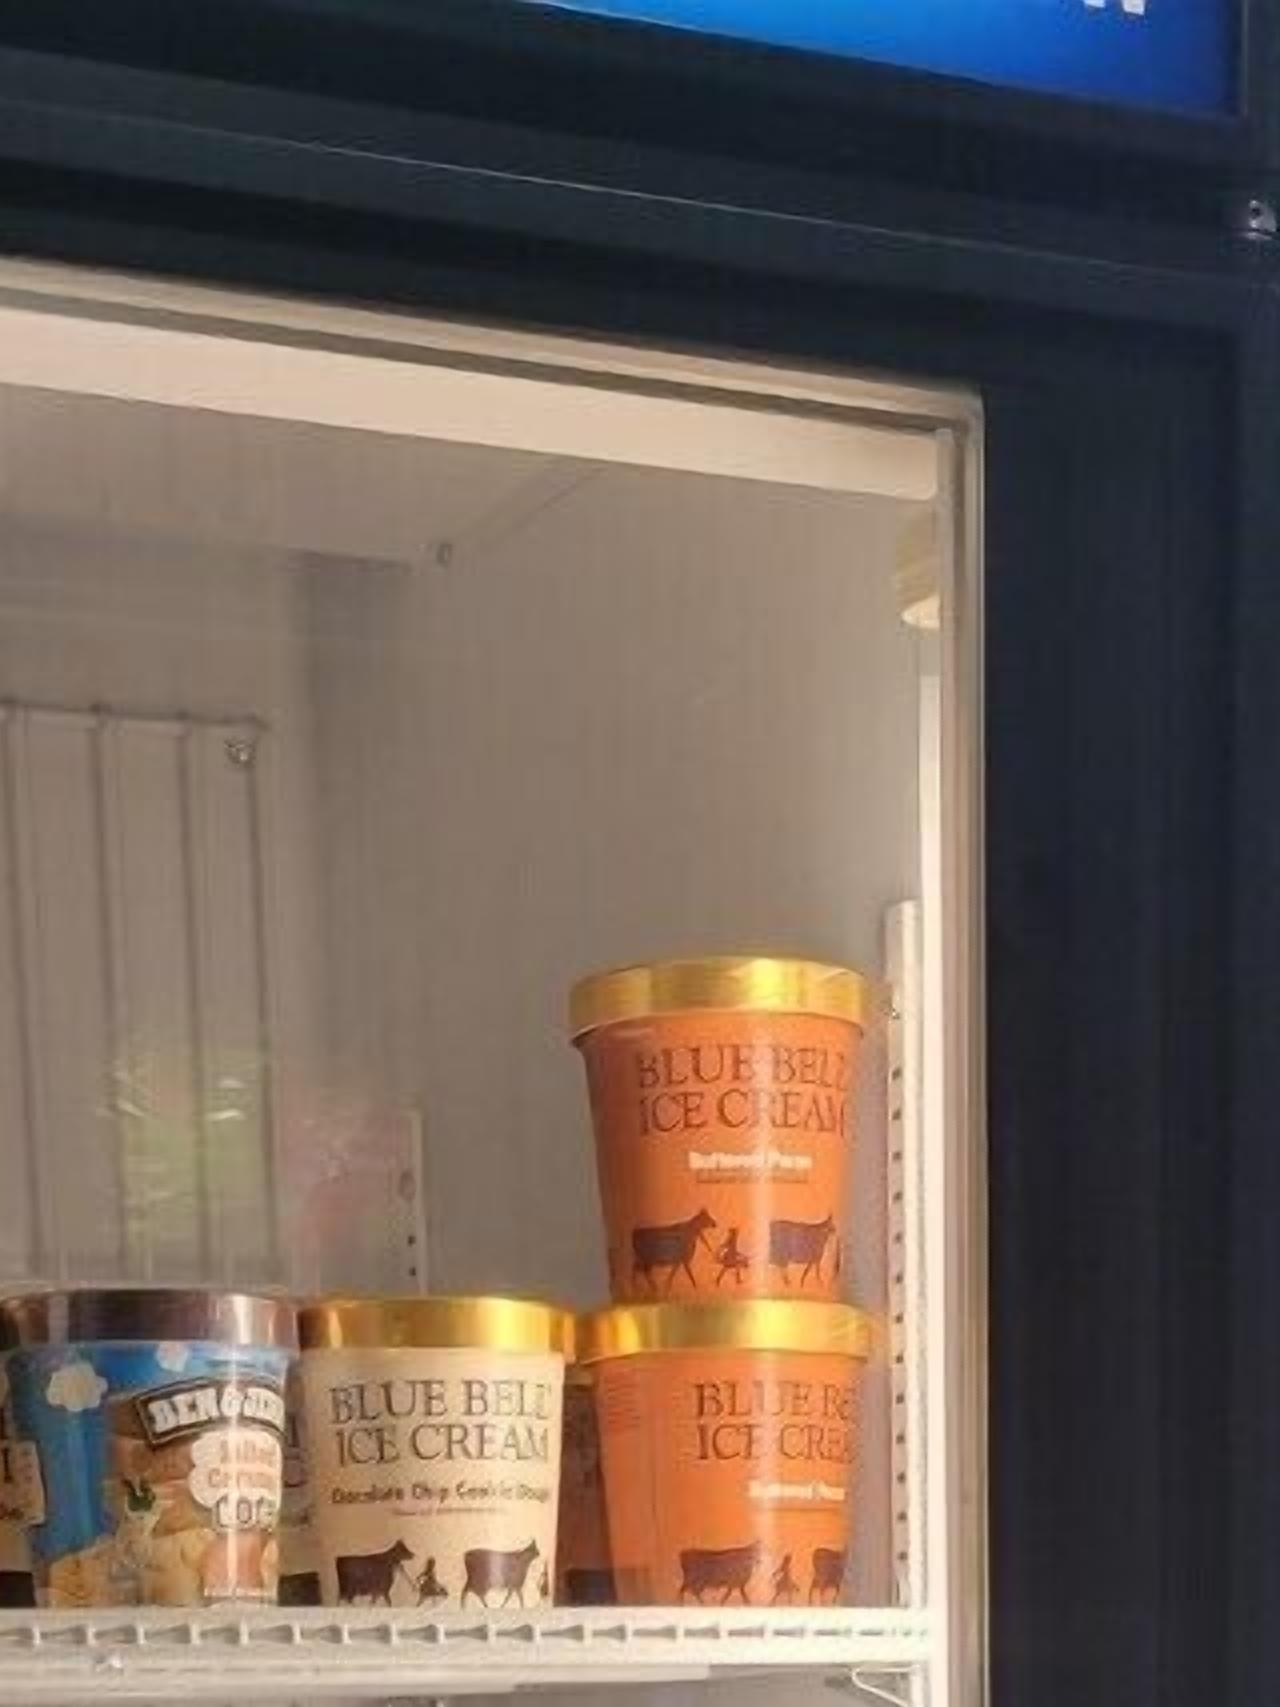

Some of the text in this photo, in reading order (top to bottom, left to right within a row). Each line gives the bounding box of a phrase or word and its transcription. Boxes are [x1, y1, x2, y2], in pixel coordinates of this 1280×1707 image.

[637, 1046, 753, 1088] BLUE
[639, 1092, 707, 1136] ICE
[329, 1379, 447, 1424] BLUE
[695, 1380, 811, 1418] BLUE
[336, 1424, 549, 1467] ICE CREAM
[696, 1424, 760, 1460] ICE
